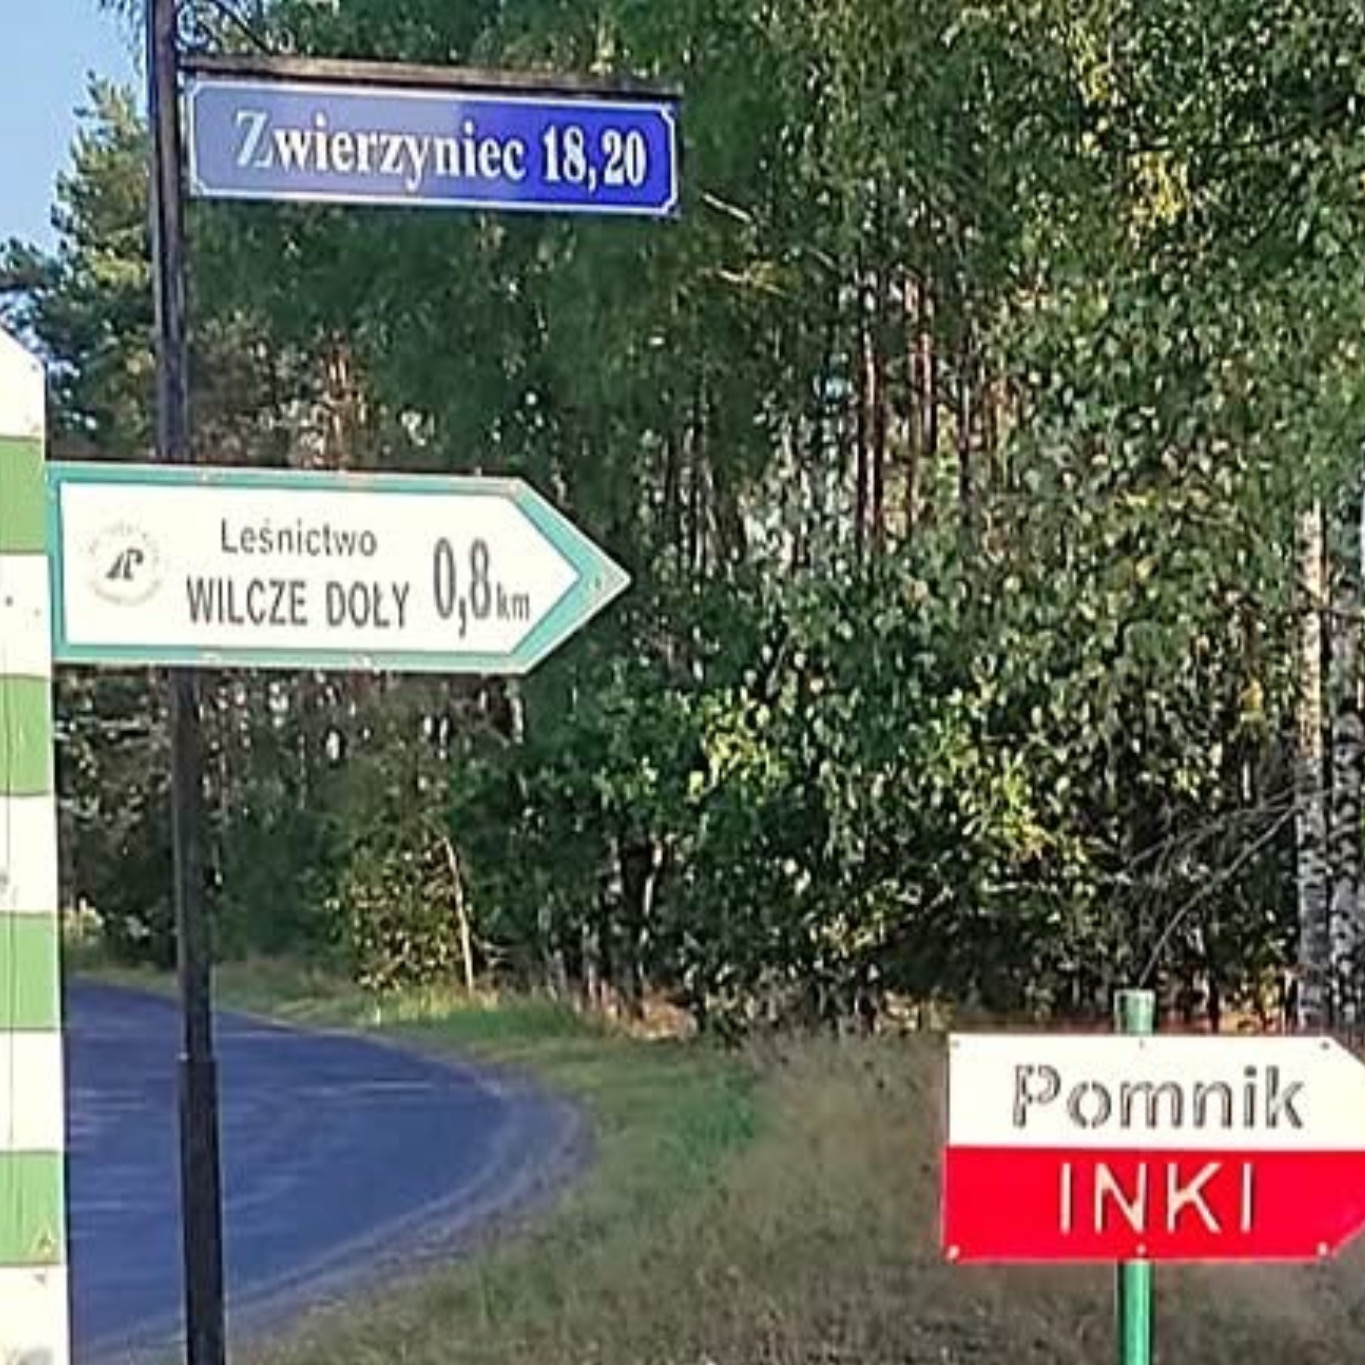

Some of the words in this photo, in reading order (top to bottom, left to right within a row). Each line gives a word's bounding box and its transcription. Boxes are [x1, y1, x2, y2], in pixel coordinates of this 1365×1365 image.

[233, 108, 527, 190] Zwierzyniec
[542, 125, 647, 192] 18,20
[219, 517, 377, 557] Leśnictwo
[186, 576, 308, 625] WILCZE
[326, 579, 410, 626] DOŁY
[1012, 1062, 1305, 1129] Pomnik
[1058, 1162, 1252, 1234] INKI
